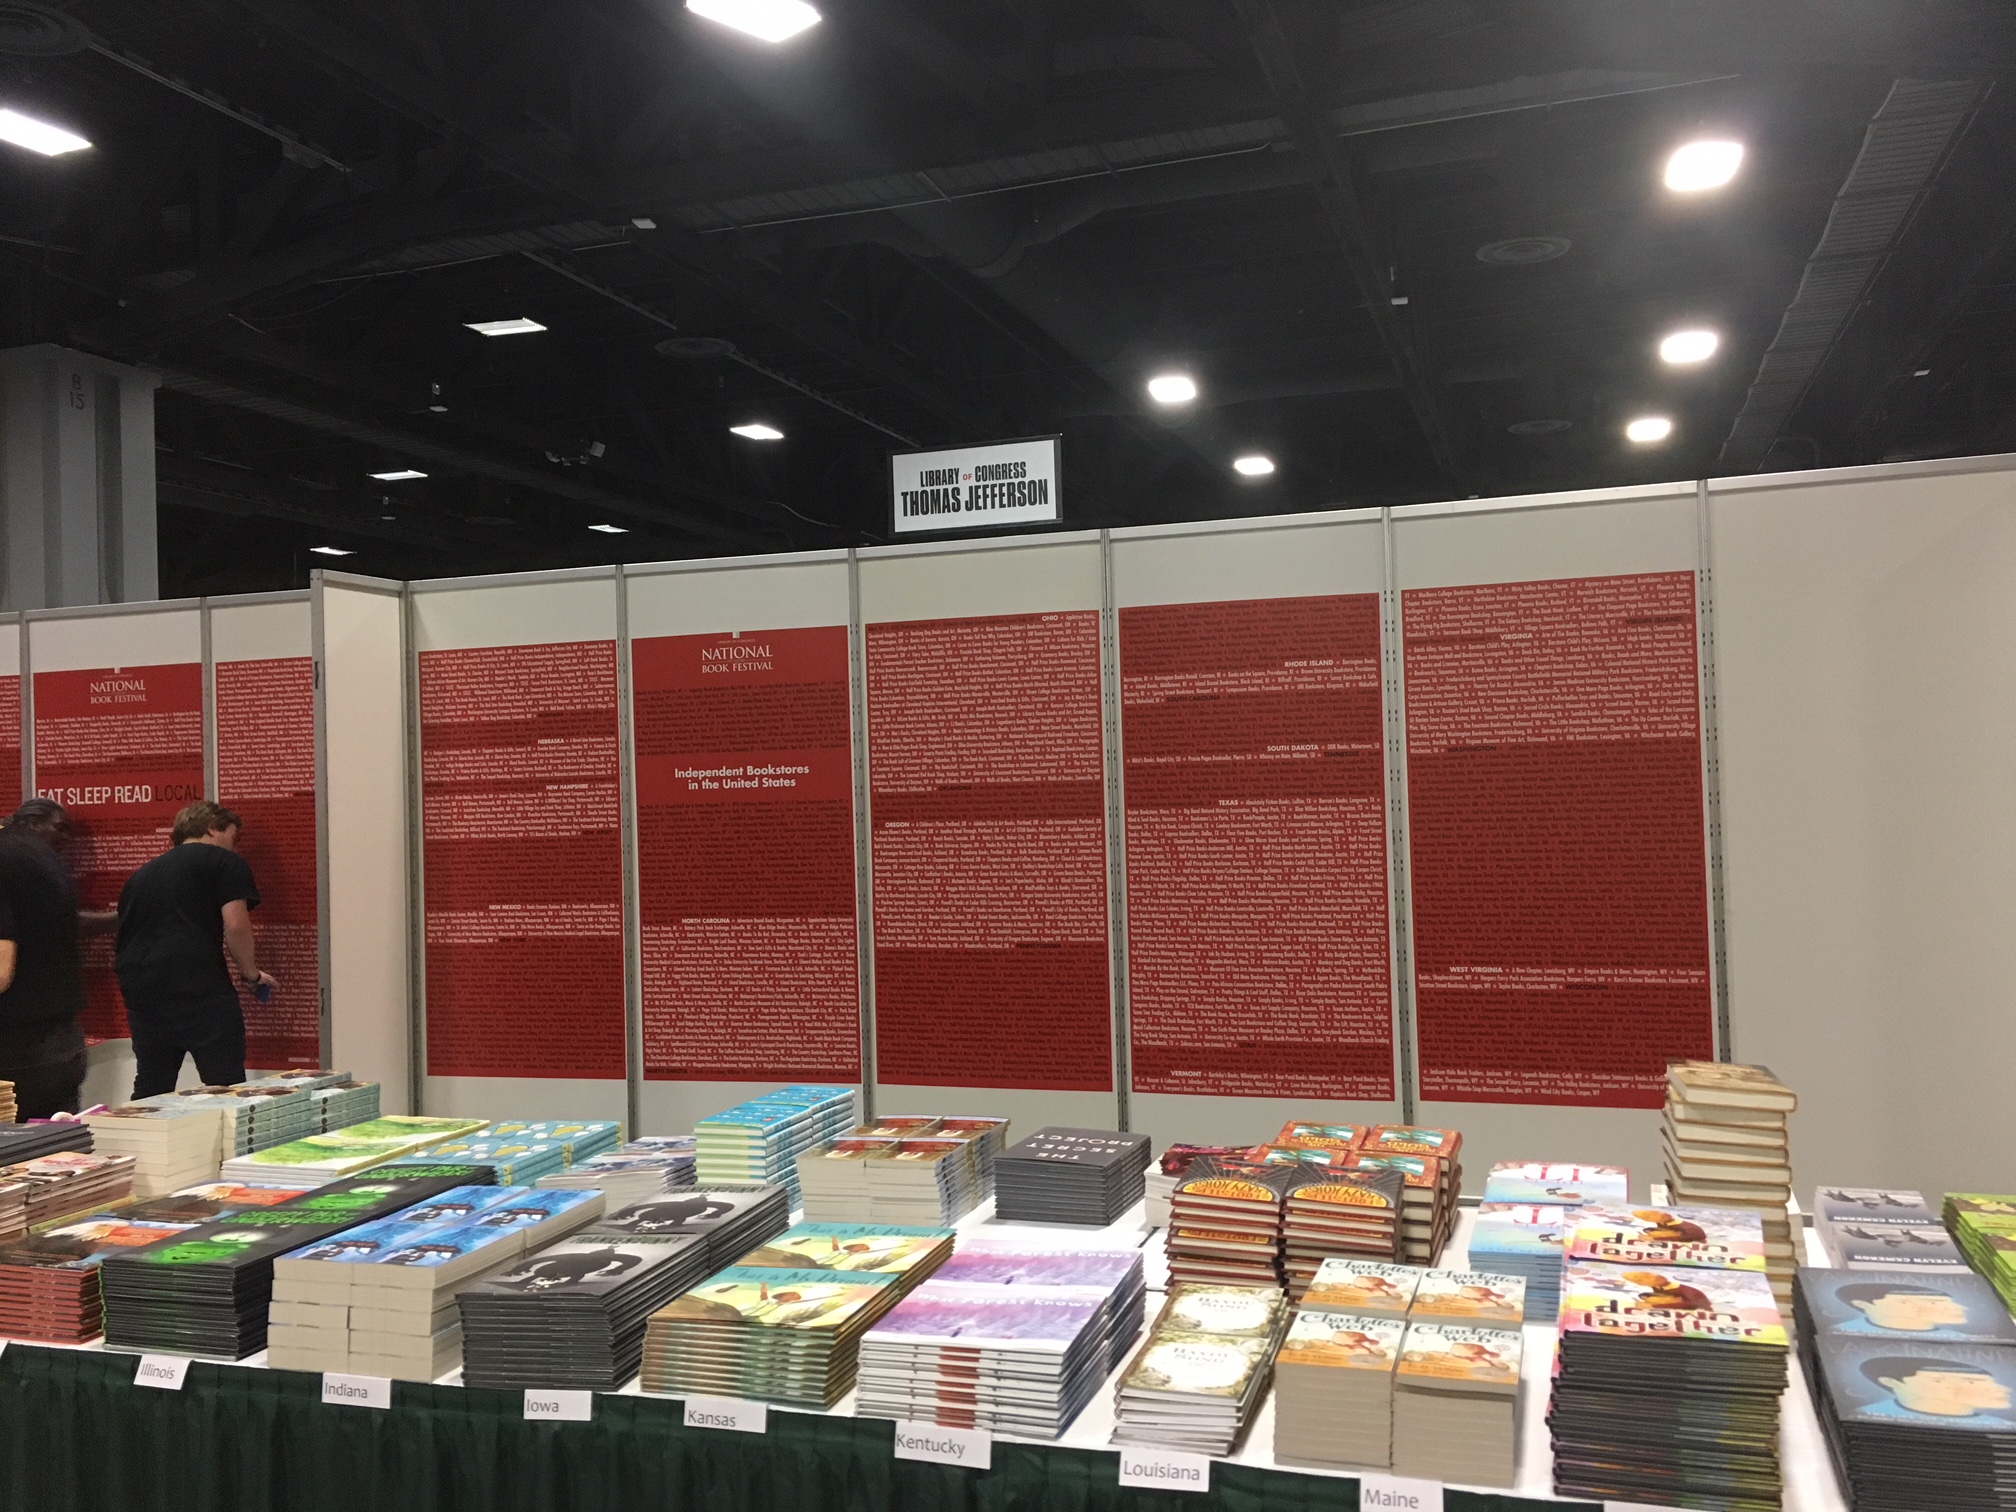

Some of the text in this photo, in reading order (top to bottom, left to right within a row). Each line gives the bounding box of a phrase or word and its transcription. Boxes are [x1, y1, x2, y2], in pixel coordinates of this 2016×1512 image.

[72, 373, 82, 390] B
[69, 391, 85, 410] 15
[920, 461, 1027, 488] LIBRARY OF CONGRESS
[900, 479, 1049, 517] THOMAS JEFFERSON
[1500, 632, 1533, 640] VIRGINIA
[701, 645, 773, 661] NATIONAL
[701, 661, 774, 674] BOOK FESTIVAL
[1284, 660, 1308, 668] RHODE
[1309, 659, 1334, 667] ISLAND
[90, 679, 146, 693] NATIONAL
[90, 693, 147, 705] BOOK FESTIVAL
[674, 764, 810, 780] Independent Bookstores
[688, 777, 796, 790] in the United States
[38, 784, 202, 806] EAT SLEEP READ LOCAL
[1470, 966, 1503, 974] VIRGINIA
[1033, 1133, 1134, 1146] PROJECT
[1025, 1142, 1117, 1154] SECRET
[1035, 1152, 1080, 1160] THE
[1833, 1215, 1886, 1224] CAMERON
[1589, 1242, 1746, 1264] together
[1853, 1254, 1958, 1264] EVELYN CAMERON
[1594, 1299, 1741, 1322] drawn
[1583, 1312, 1762, 1336] together
[140, 1363, 175, 1380] Illinois
[325, 1382, 369, 1400] Indiana
[526, 1399, 560, 1413] Iowa
[688, 1409, 737, 1429] Kansas
[896, 1432, 966, 1459] Kentucky
[1123, 1459, 1201, 1482] Louisiana
[1364, 1488, 1420, 1510] Maine
